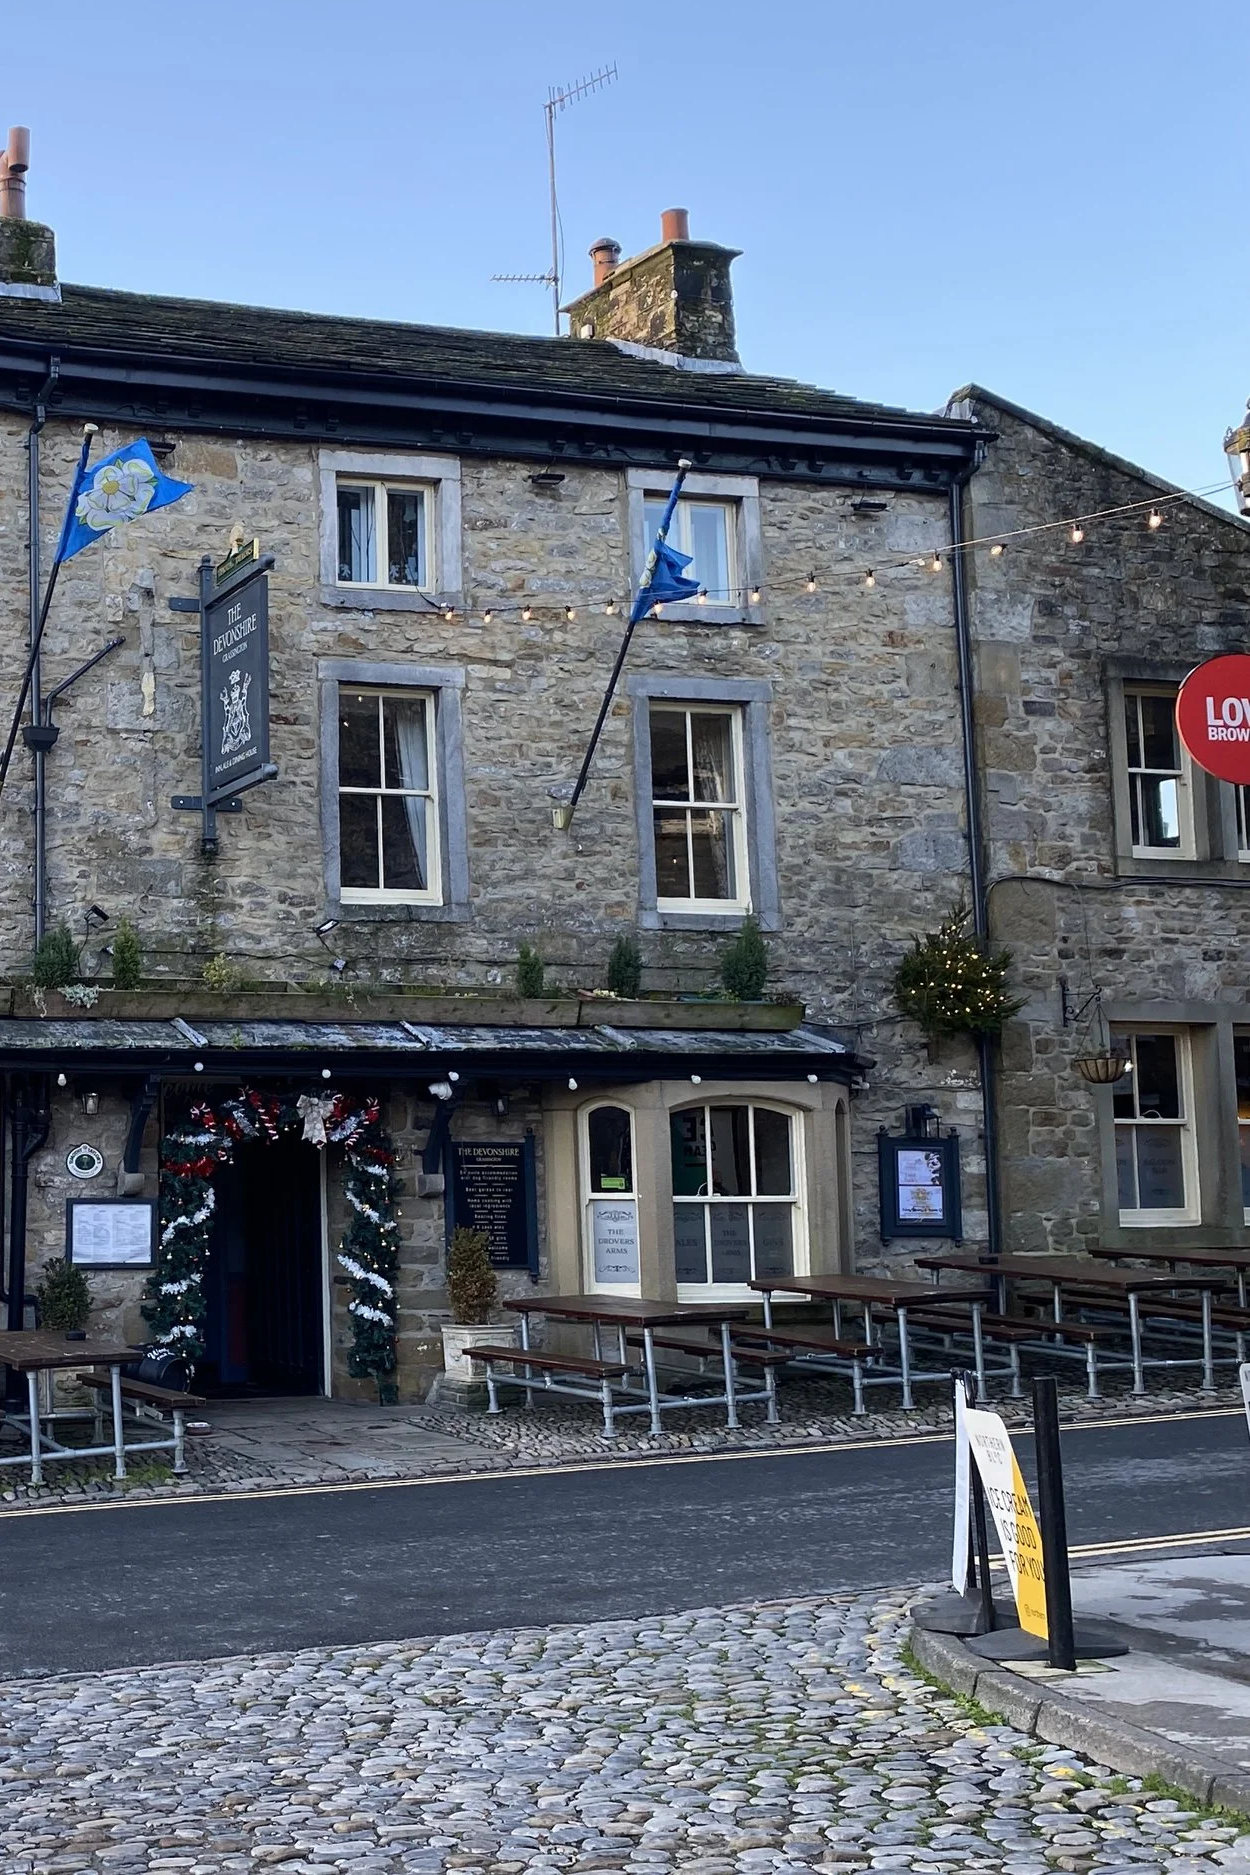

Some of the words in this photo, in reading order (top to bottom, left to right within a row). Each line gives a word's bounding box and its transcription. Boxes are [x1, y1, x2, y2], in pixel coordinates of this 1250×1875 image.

[227, 602, 242, 626] THE
[213, 613, 257, 656] DEVONSHIRE
[458, 1147, 472, 1156] THE
[473, 1147, 520, 1156] DEVONSHIRE
[987, 1487, 999, 1509] ICE
[1000, 1490, 1033, 1518] CREAM
[1000, 1518, 1012, 1542] IS
[1010, 1521, 1037, 1550] GOOD
[1009, 1550, 1029, 1577] FOR
